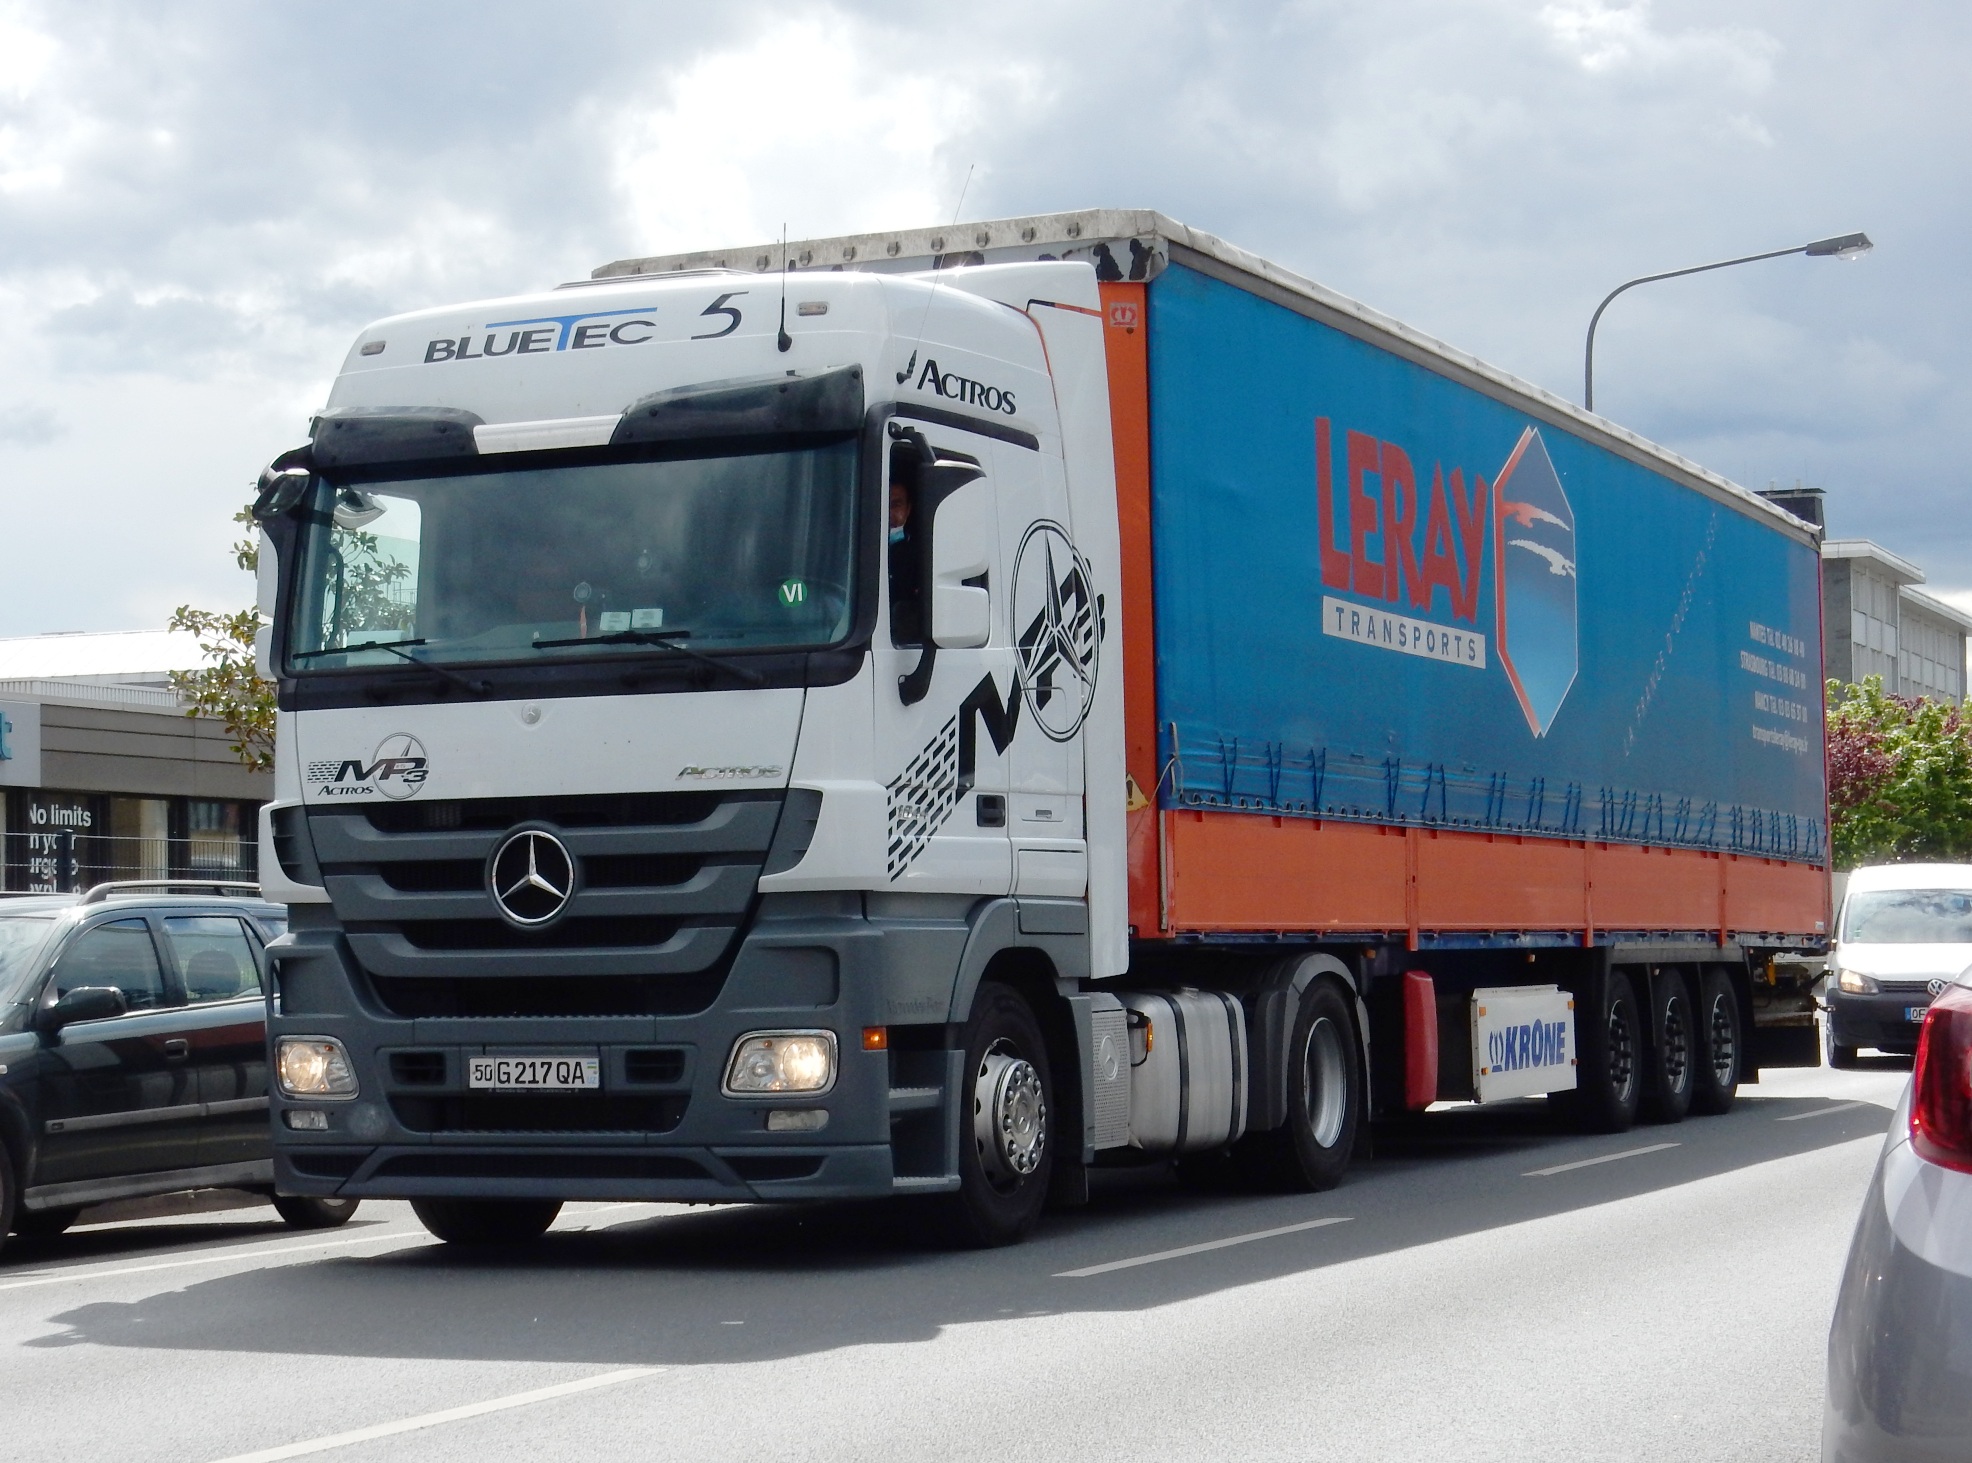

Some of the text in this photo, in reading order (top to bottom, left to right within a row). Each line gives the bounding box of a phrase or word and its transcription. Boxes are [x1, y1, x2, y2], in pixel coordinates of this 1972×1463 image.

[424, 291, 750, 363] BLUETEC 5
[917, 359, 1017, 415] ACTROS
[1315, 416, 1488, 625] LERAY
[782, 583, 803, 602] VI
[1336, 606, 1477, 662] TRANSPORTS
[51, 804, 92, 827] limits
